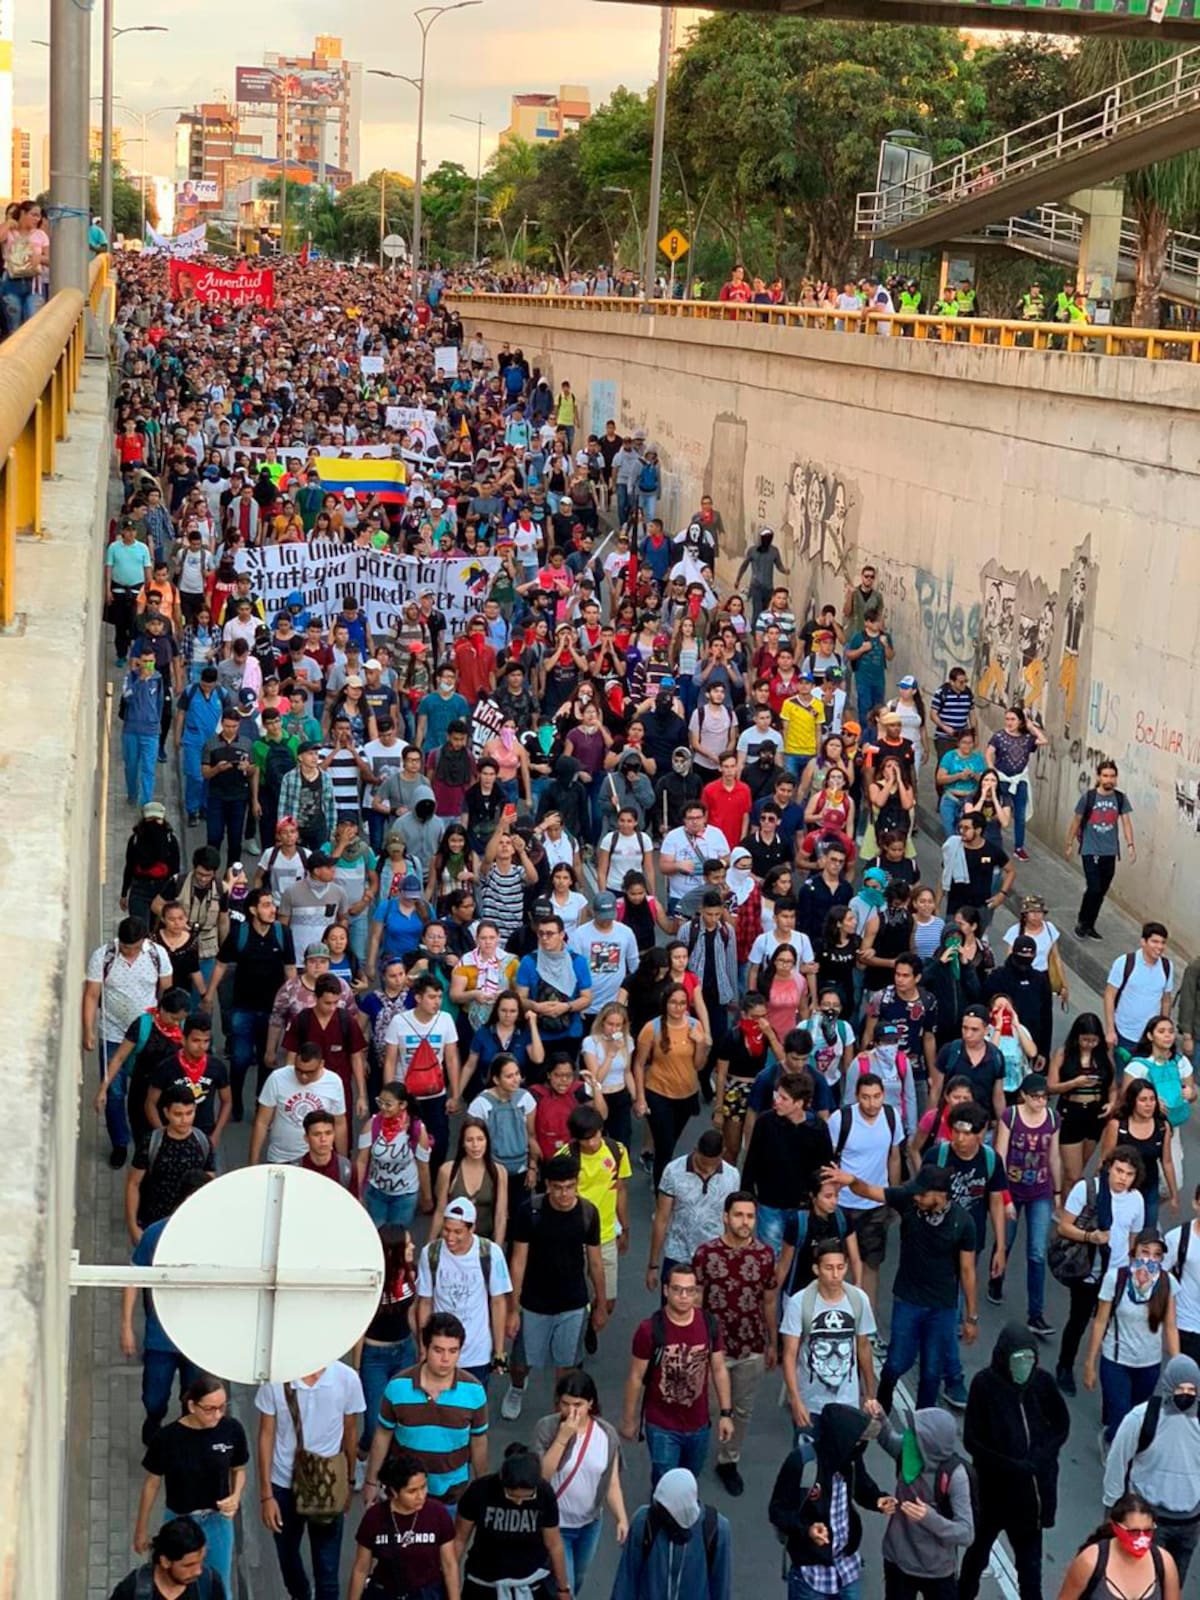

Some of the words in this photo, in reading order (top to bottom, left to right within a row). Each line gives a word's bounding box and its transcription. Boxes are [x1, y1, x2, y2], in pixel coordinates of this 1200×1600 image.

[197, 272, 262, 291] Juventud
[280, 545, 299, 566] la
[356, 555, 407, 582] para
[417, 559, 436, 584] la
[485, 1506, 539, 1533] FRIDAY
